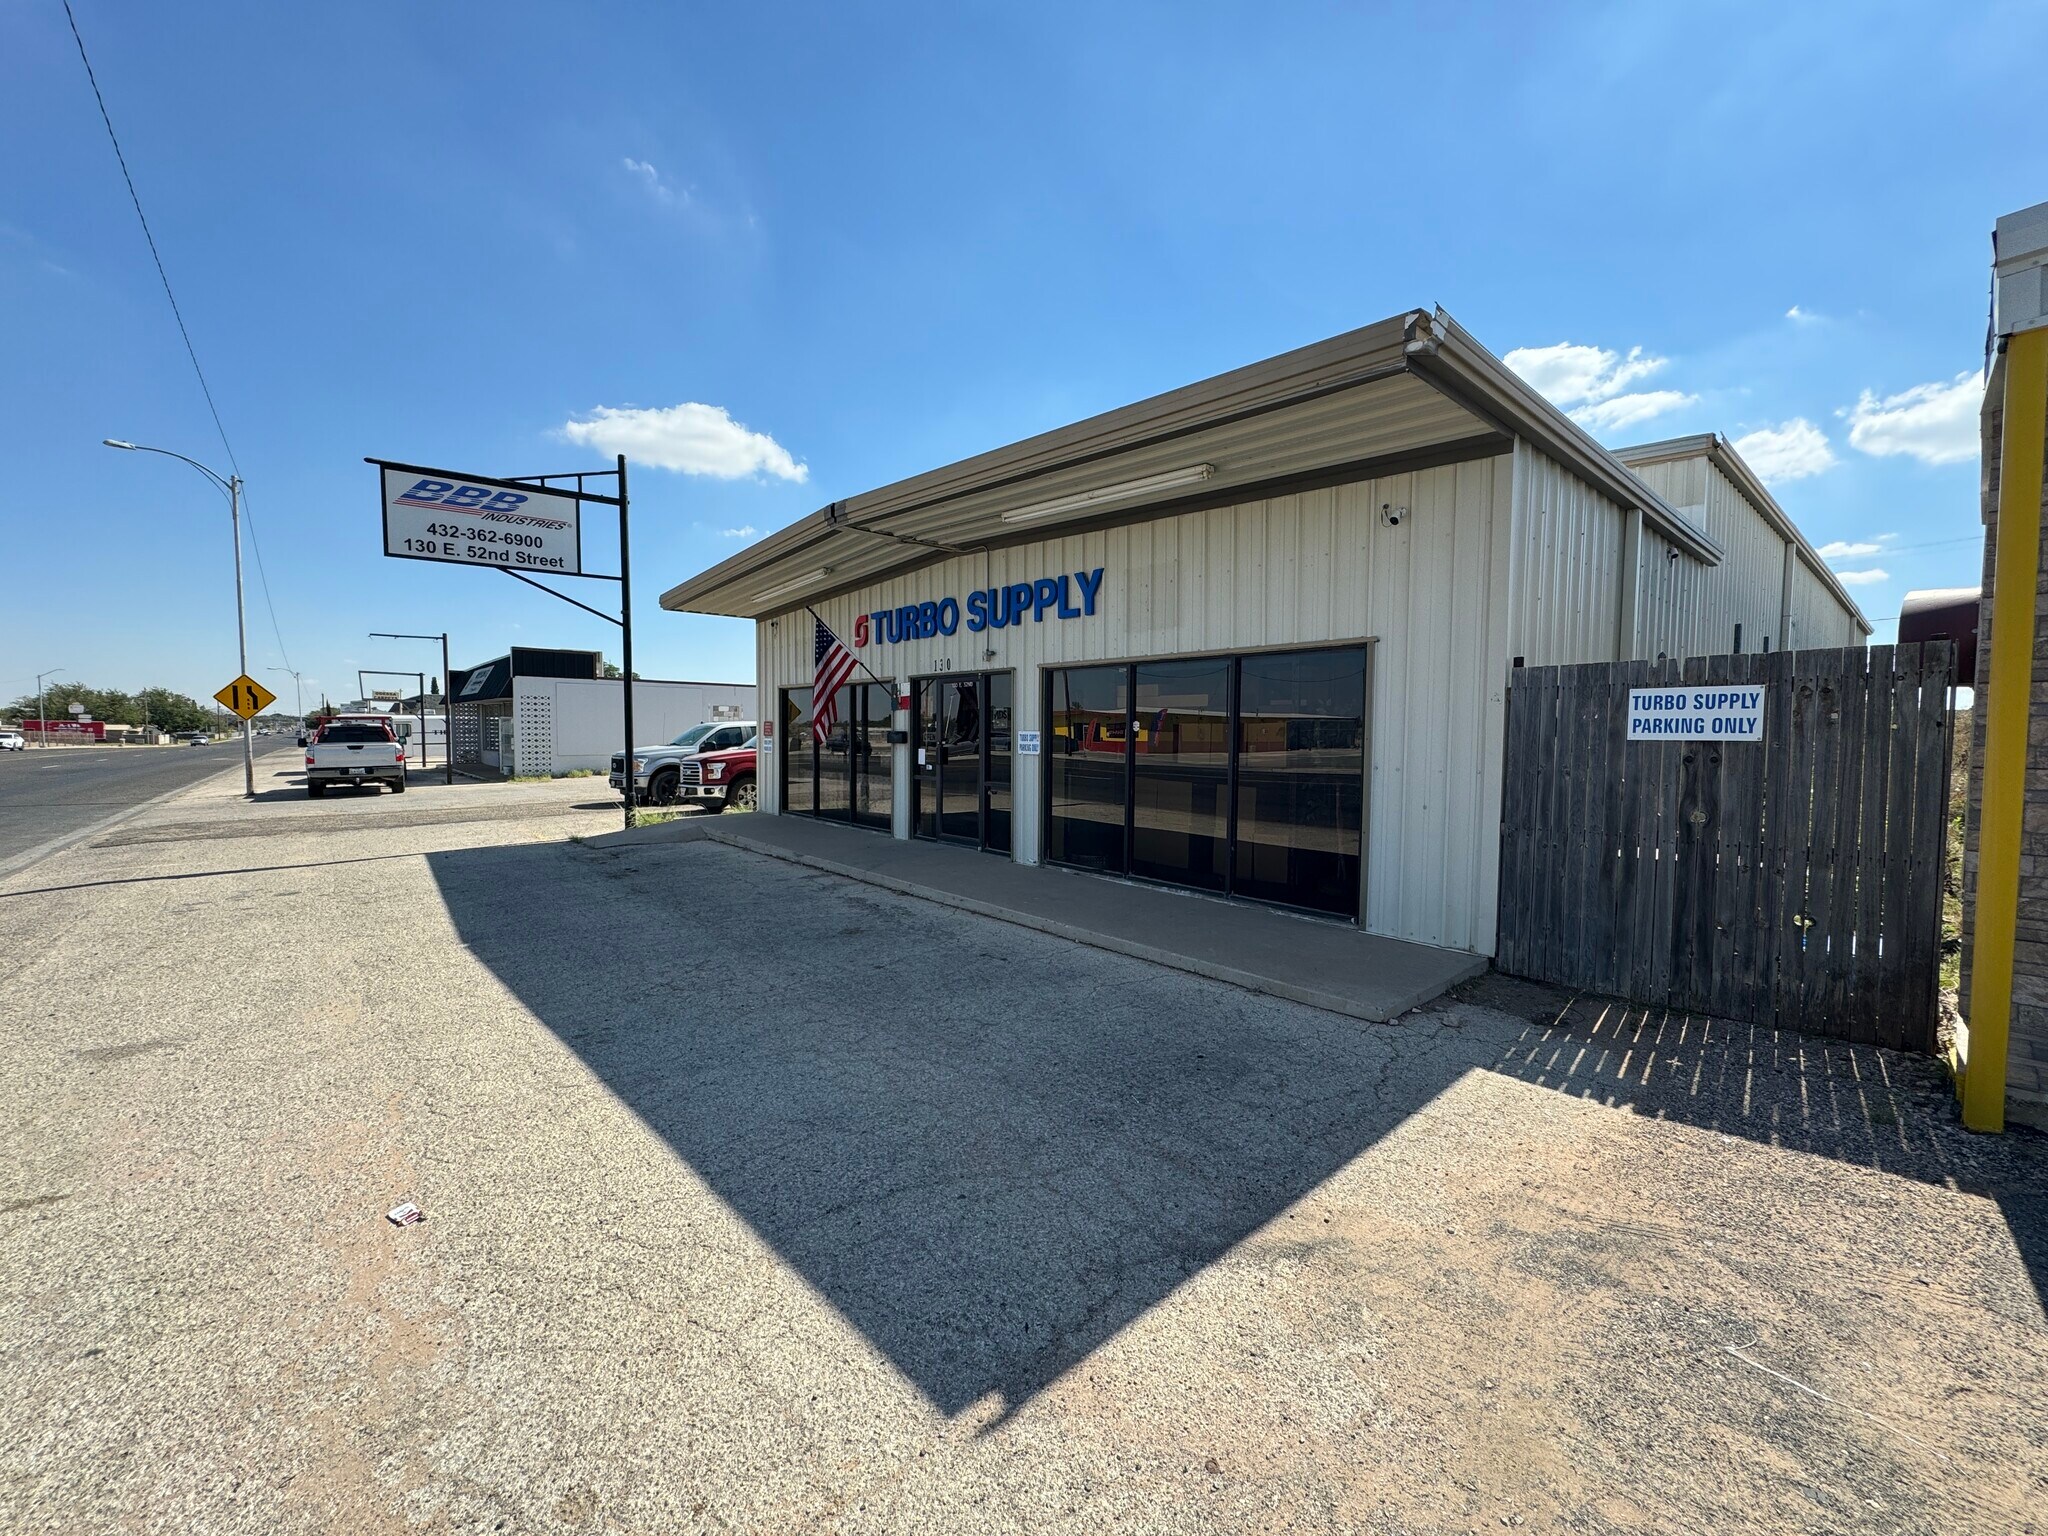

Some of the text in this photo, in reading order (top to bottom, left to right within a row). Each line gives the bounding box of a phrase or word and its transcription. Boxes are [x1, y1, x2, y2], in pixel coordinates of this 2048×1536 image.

[400, 479, 529, 512] BBB
[481, 512, 568, 531] INDUSTRIES
[427, 522, 543, 549] 432-362-6900
[404, 538, 565, 568] 130 E. 52nd Street
[870, 597, 960, 645] TURBO
[967, 568, 1105, 632] SUPPLY
[934, 658, 951, 671] 130
[1632, 693, 1760, 710] TURBO SUPPLY
[1632, 717, 1757, 734] PARKING ONLY
